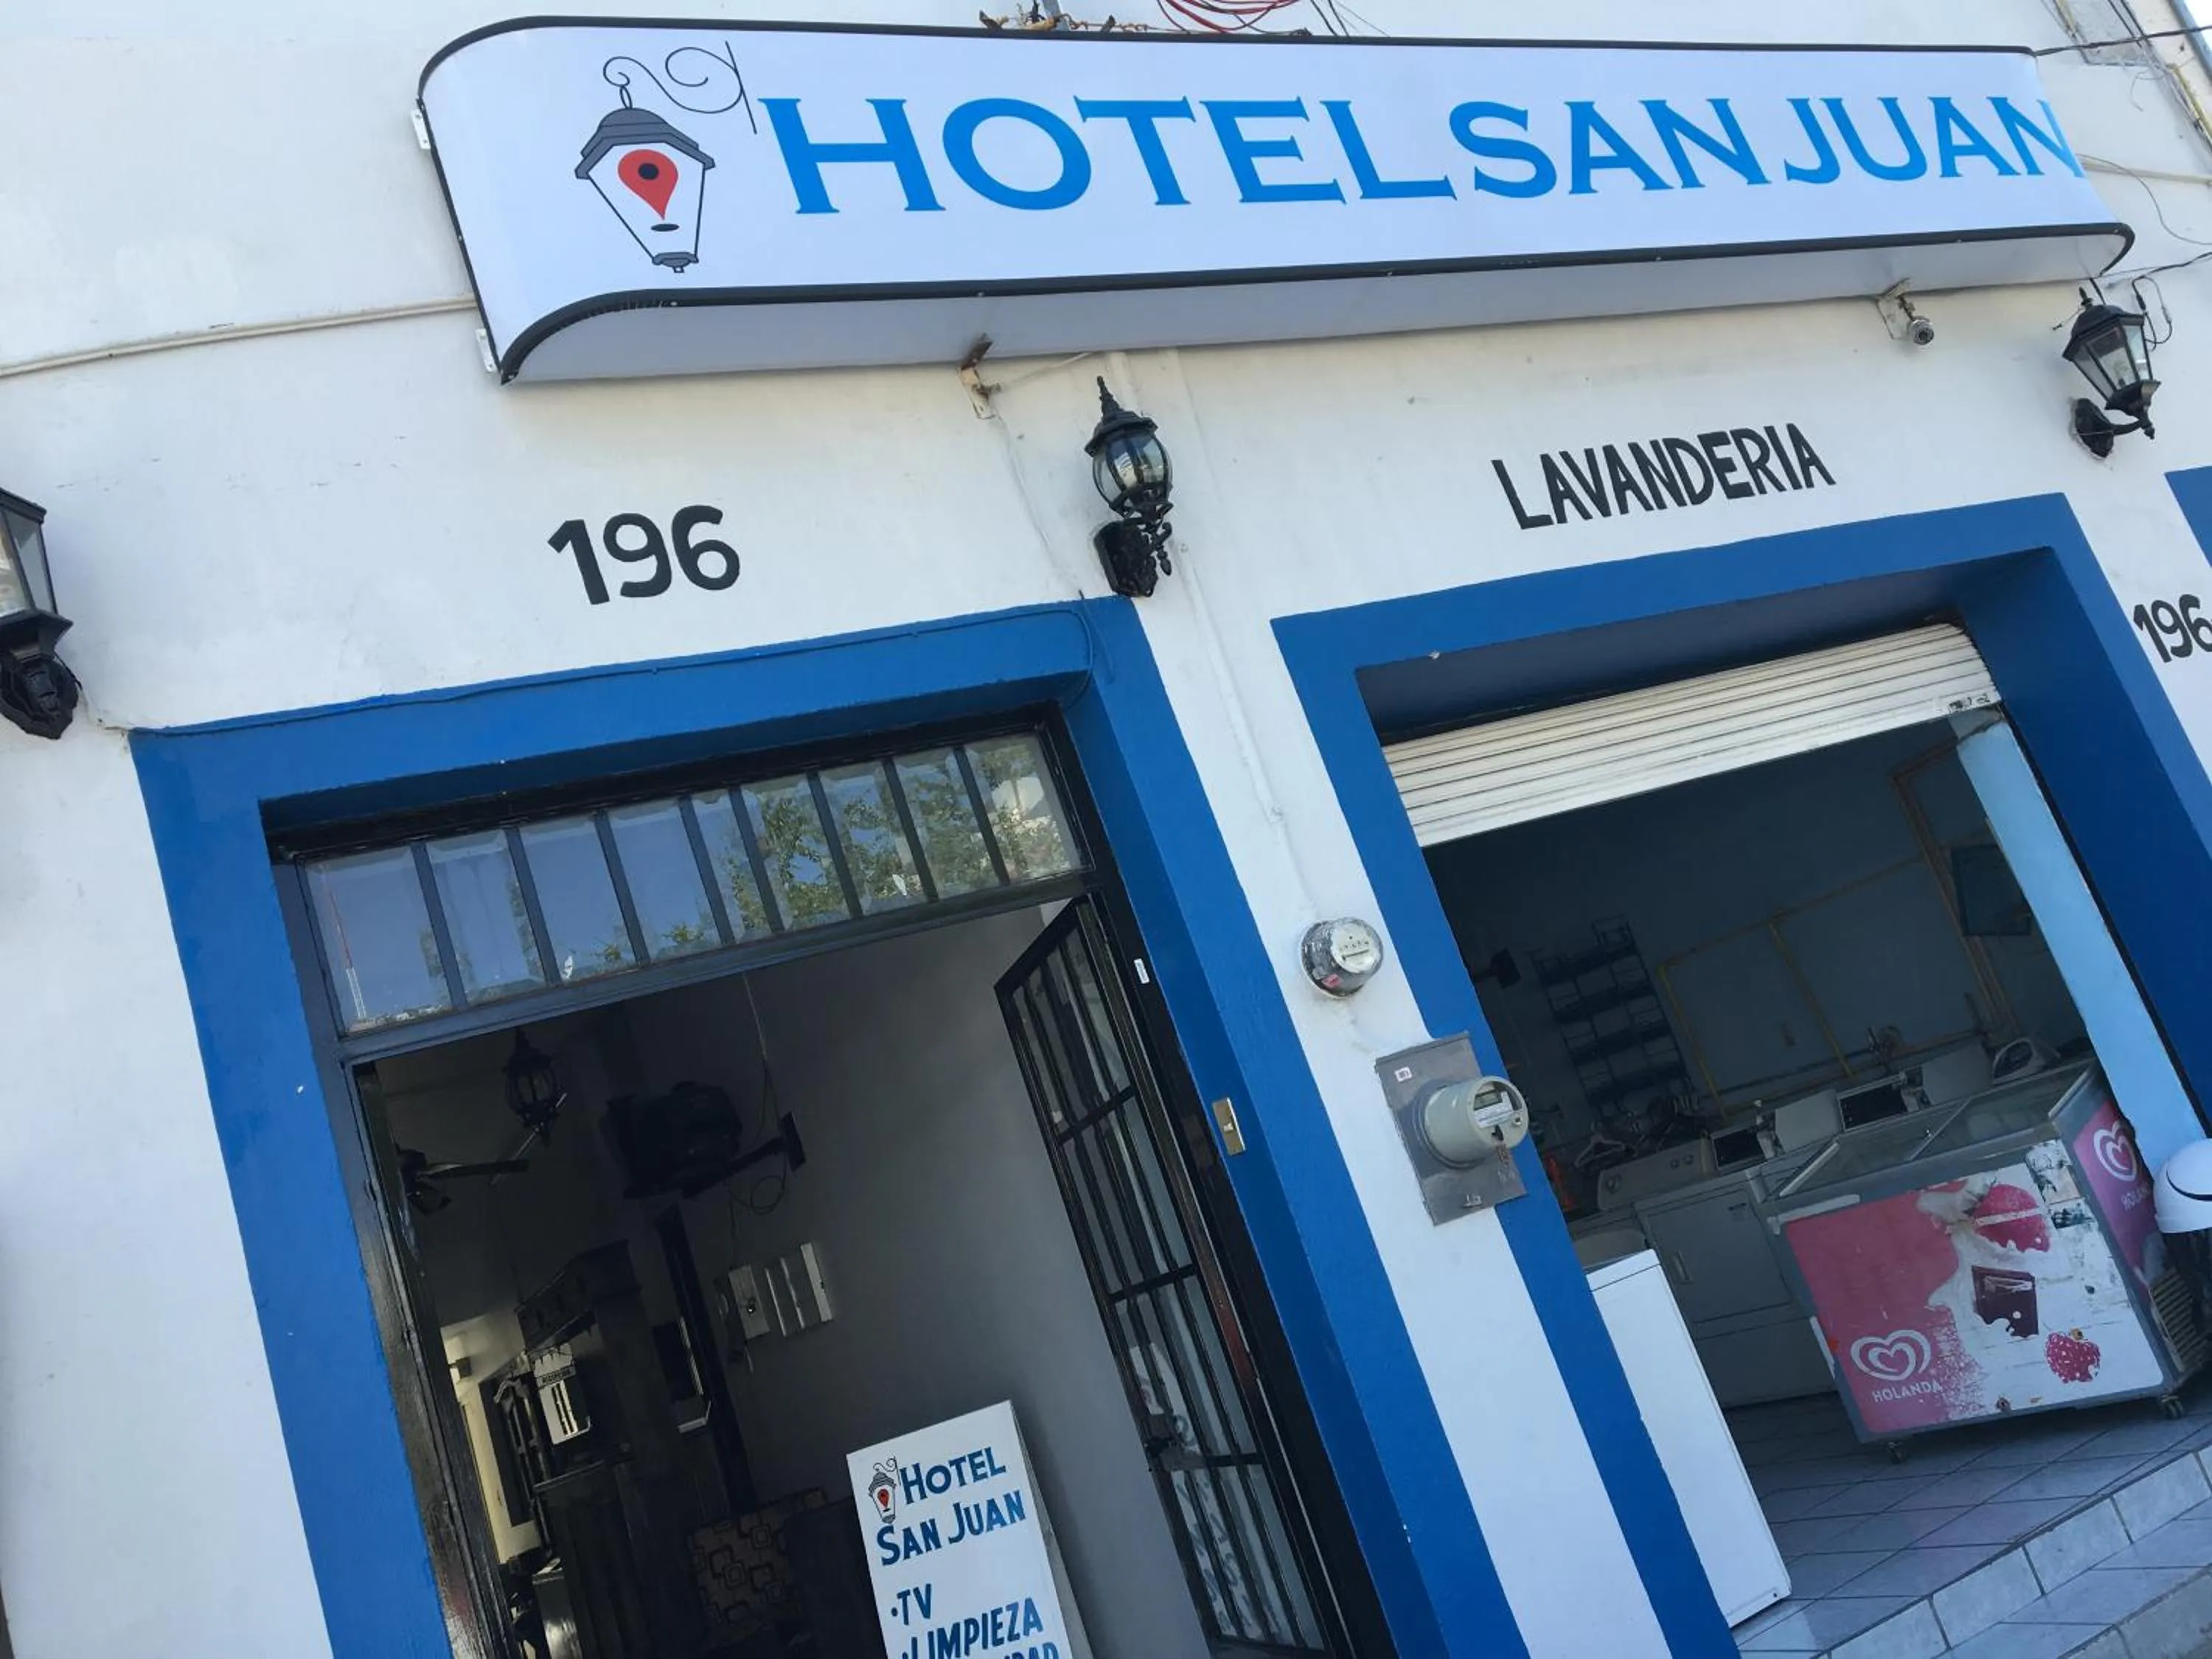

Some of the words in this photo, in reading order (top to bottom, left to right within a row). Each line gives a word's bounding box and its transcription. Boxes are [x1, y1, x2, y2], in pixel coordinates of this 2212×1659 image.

[757, 95, 1457, 215] HOTEL
[1449, 100, 1772, 198] SAN
[1783, 96, 2086, 184] JUAN
[1491, 422, 1837, 529] LAVANDERIA
[547, 504, 740, 605] 196
[2133, 594, 2212, 663] 196
[1872, 1380, 1943, 1402] HOLANDA
[900, 1447, 1006, 1505] HOTEL
[877, 1518, 942, 1566] SAN
[948, 1489, 1027, 1544] JUAN
